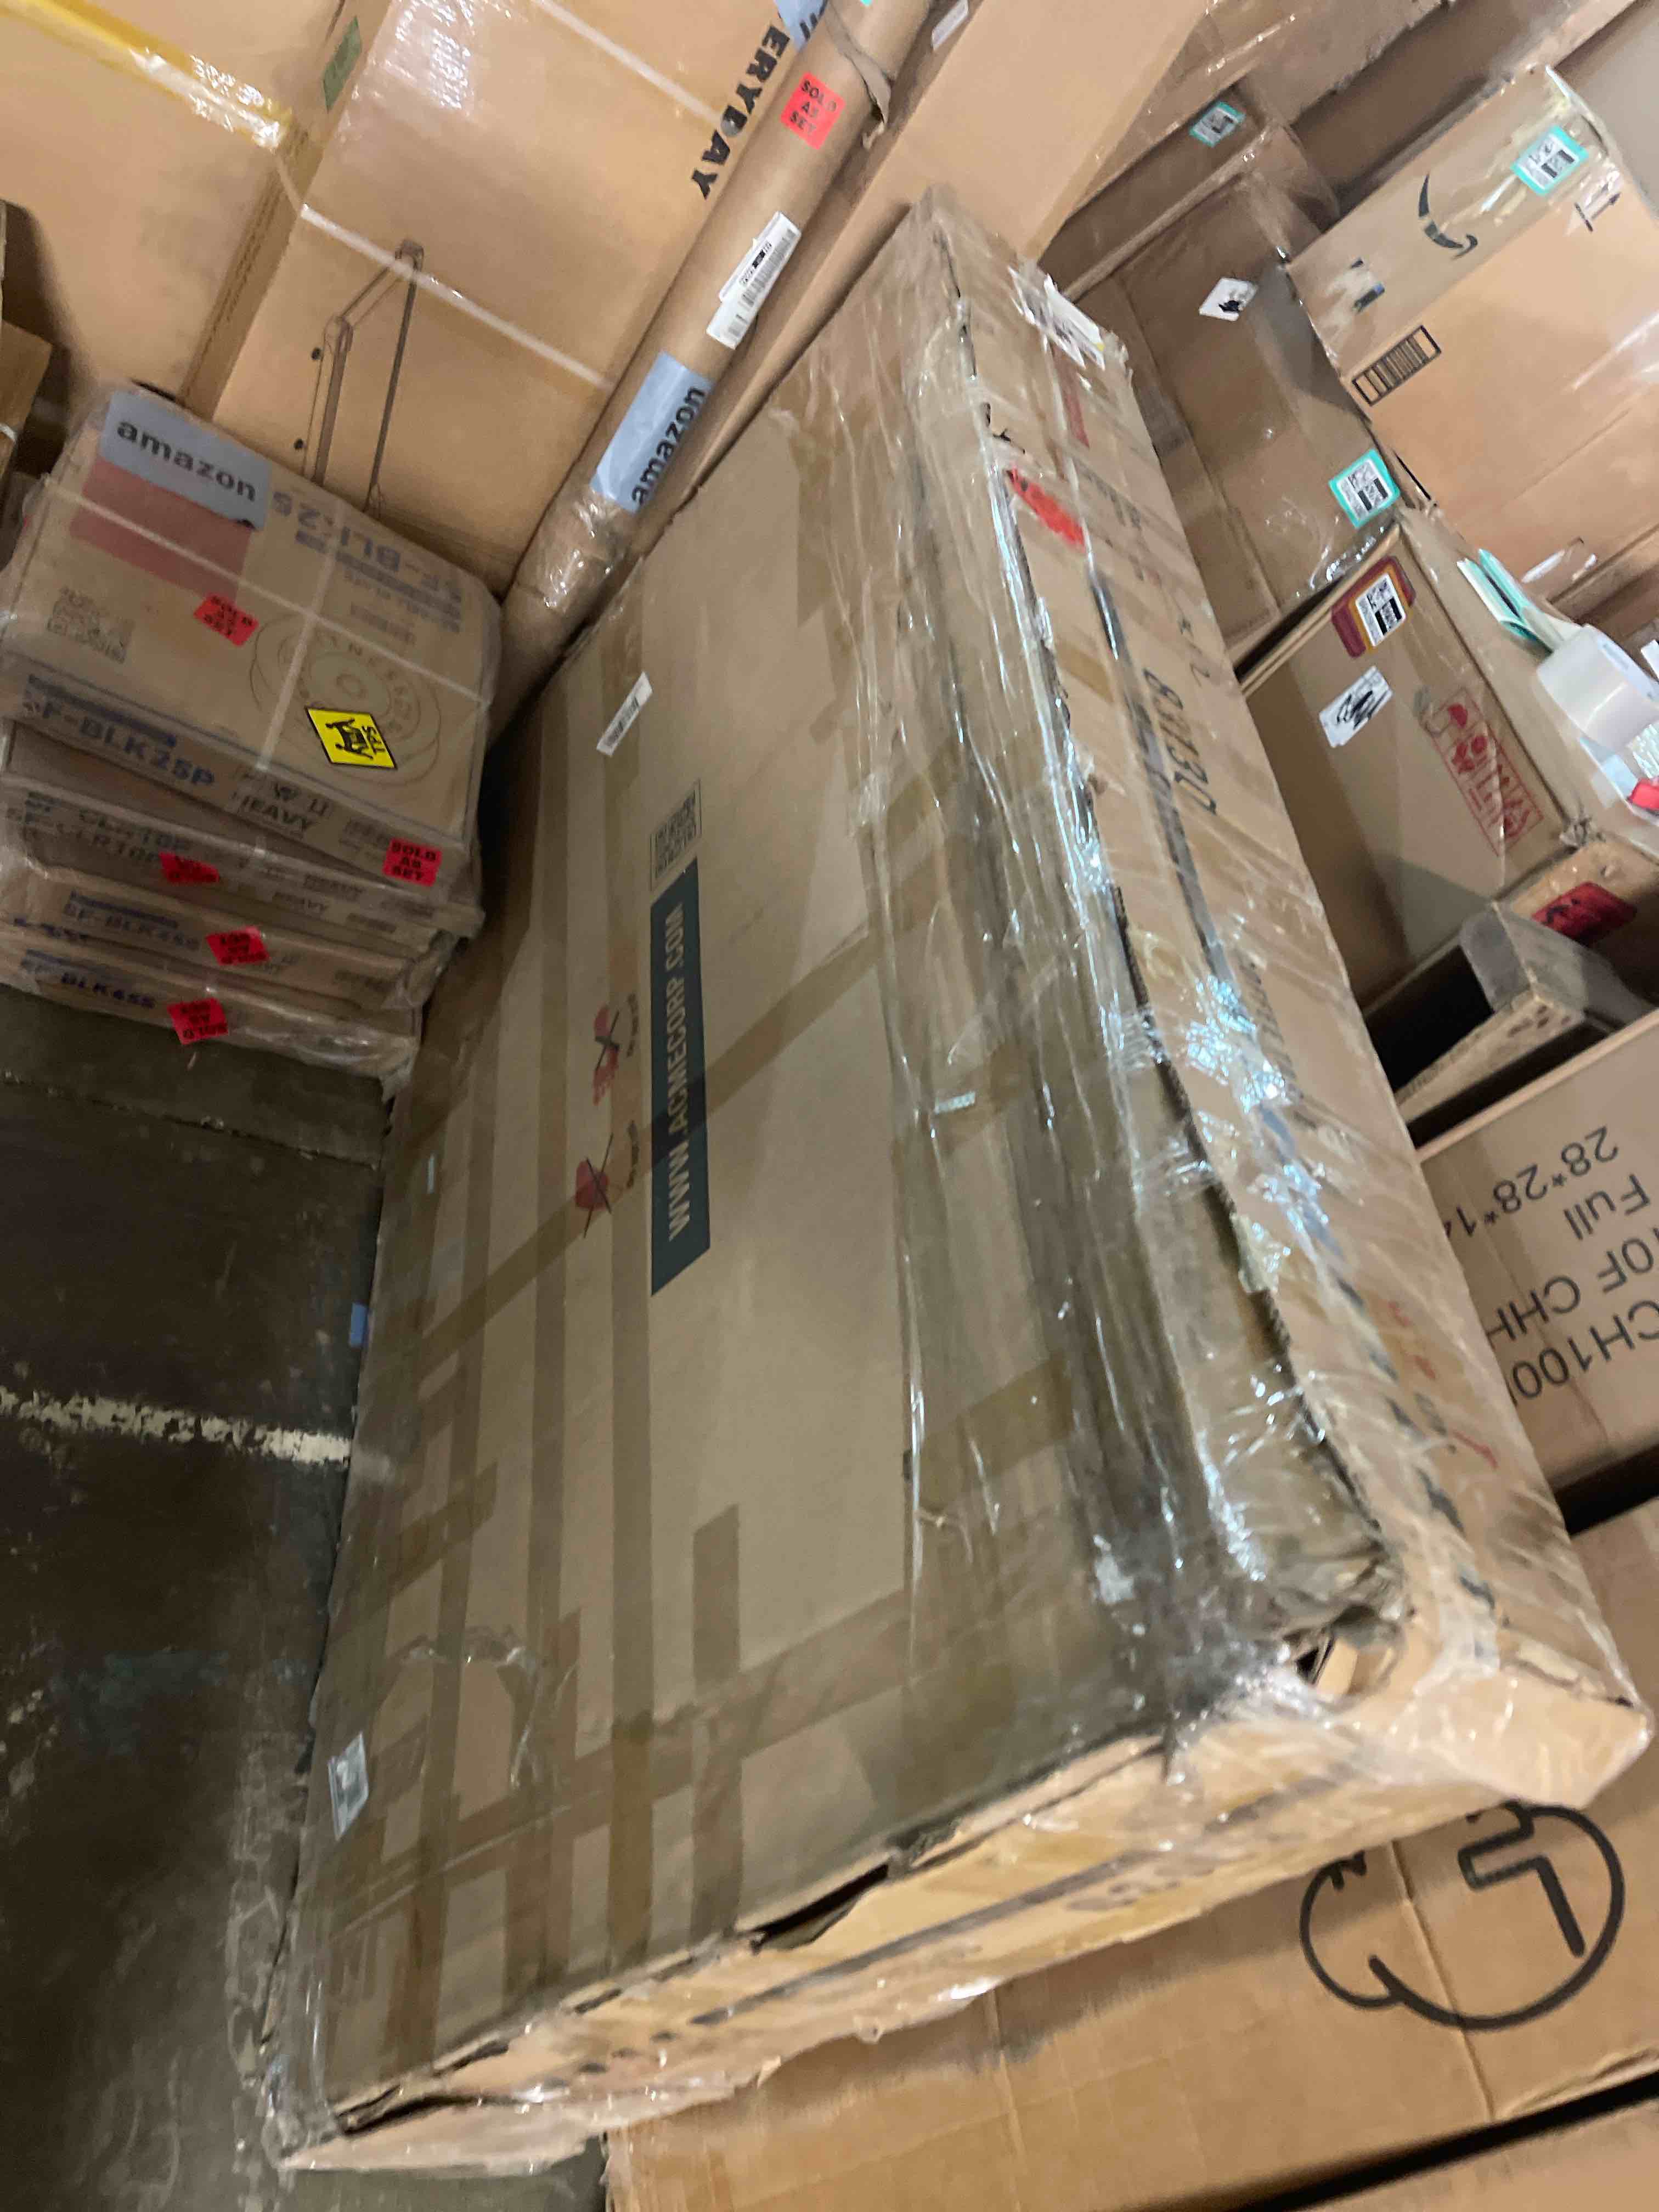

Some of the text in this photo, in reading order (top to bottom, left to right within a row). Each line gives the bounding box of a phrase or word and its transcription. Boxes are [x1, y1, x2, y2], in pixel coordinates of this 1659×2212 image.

[692, 12, 790, 200] ERYDAY
[116, 420, 256, 502] amazon
[631, 387, 706, 506] amazon
[1563, 1173, 1650, 1241] Full
[1504, 1299, 1659, 1406] CH100
